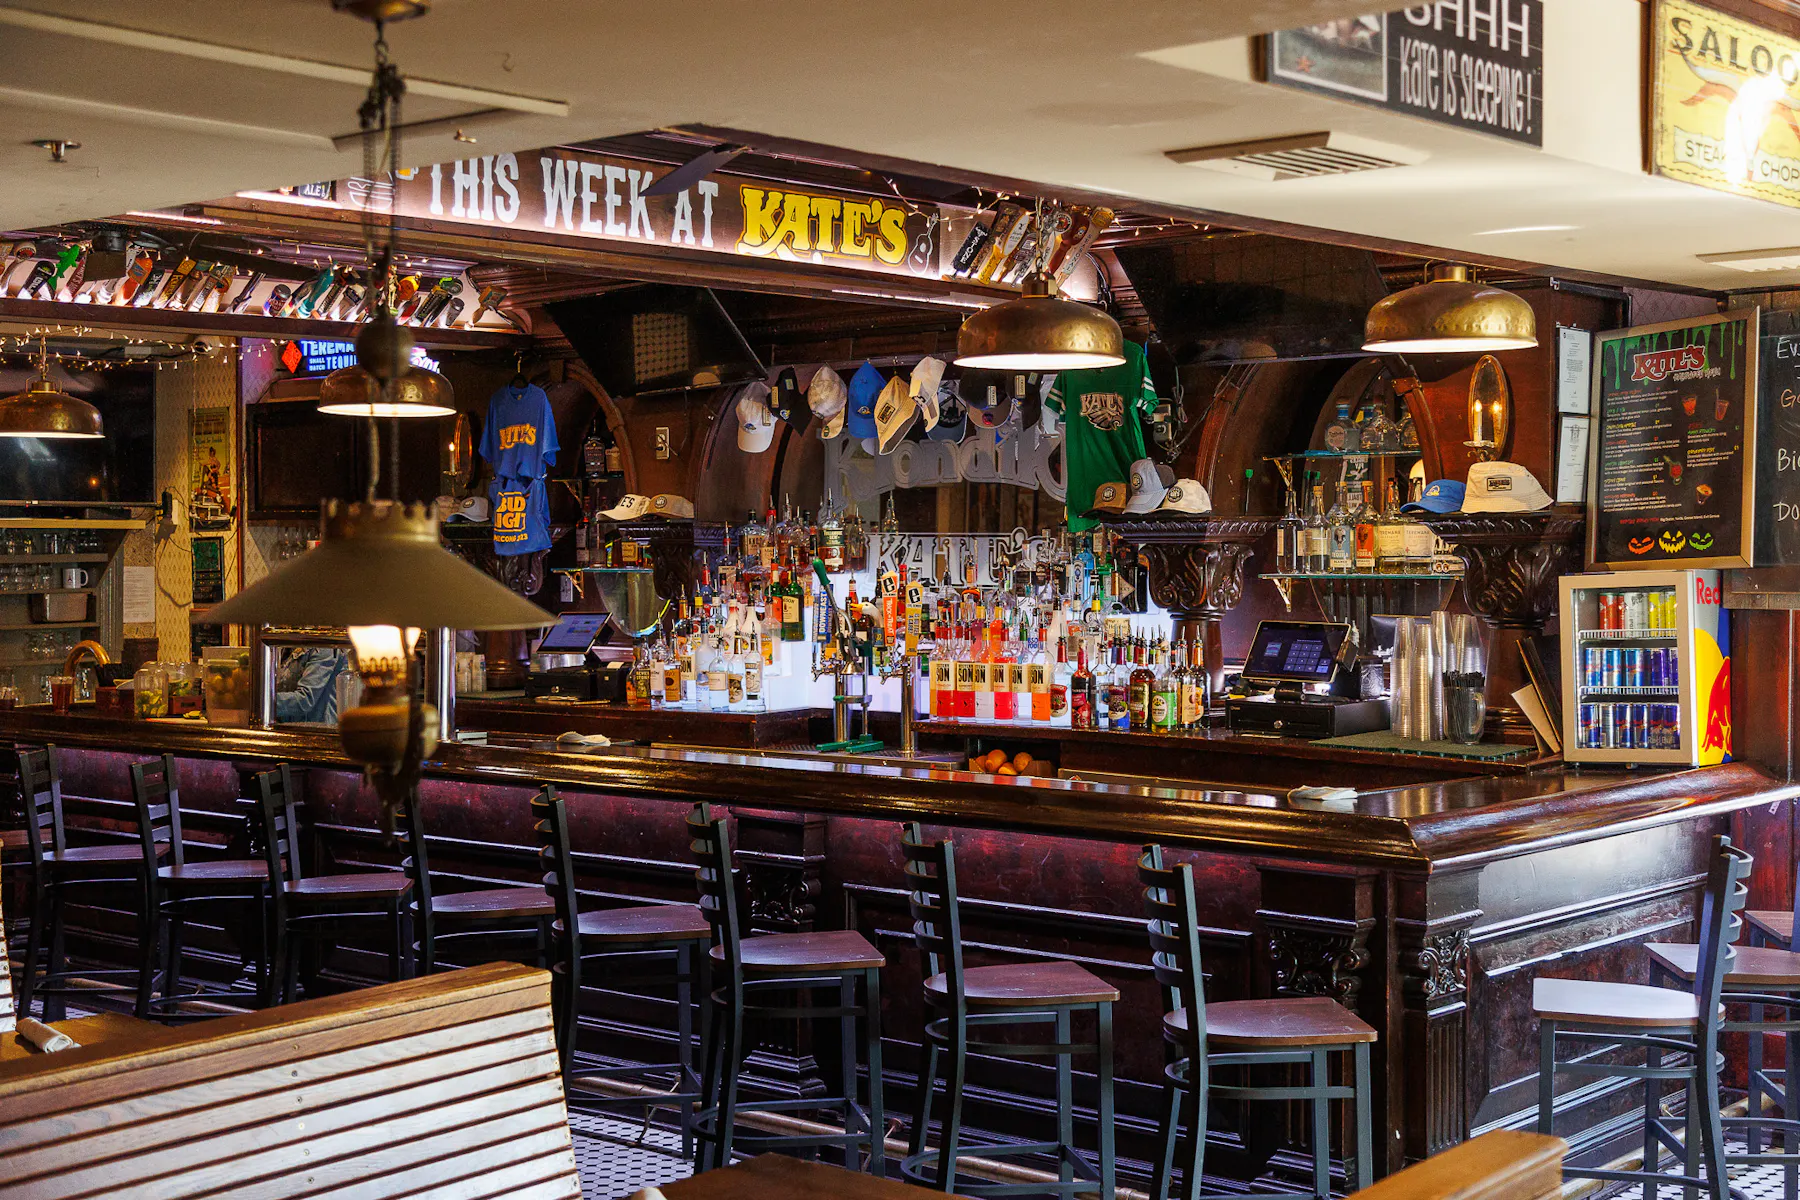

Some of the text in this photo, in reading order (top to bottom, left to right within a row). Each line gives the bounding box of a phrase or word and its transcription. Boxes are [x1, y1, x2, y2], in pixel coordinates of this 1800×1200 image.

[1442, 48, 1457, 116] IS
[1684, 138, 1727, 163] STEA
[540, 156, 656, 241] WEEK
[671, 180, 720, 249] AT
[736, 184, 909, 268] KATE'S
[1631, 344, 1706, 381] KATE'S
[1696, 576, 1721, 605] Red
[819, 591, 828, 633] DOWNEAST
